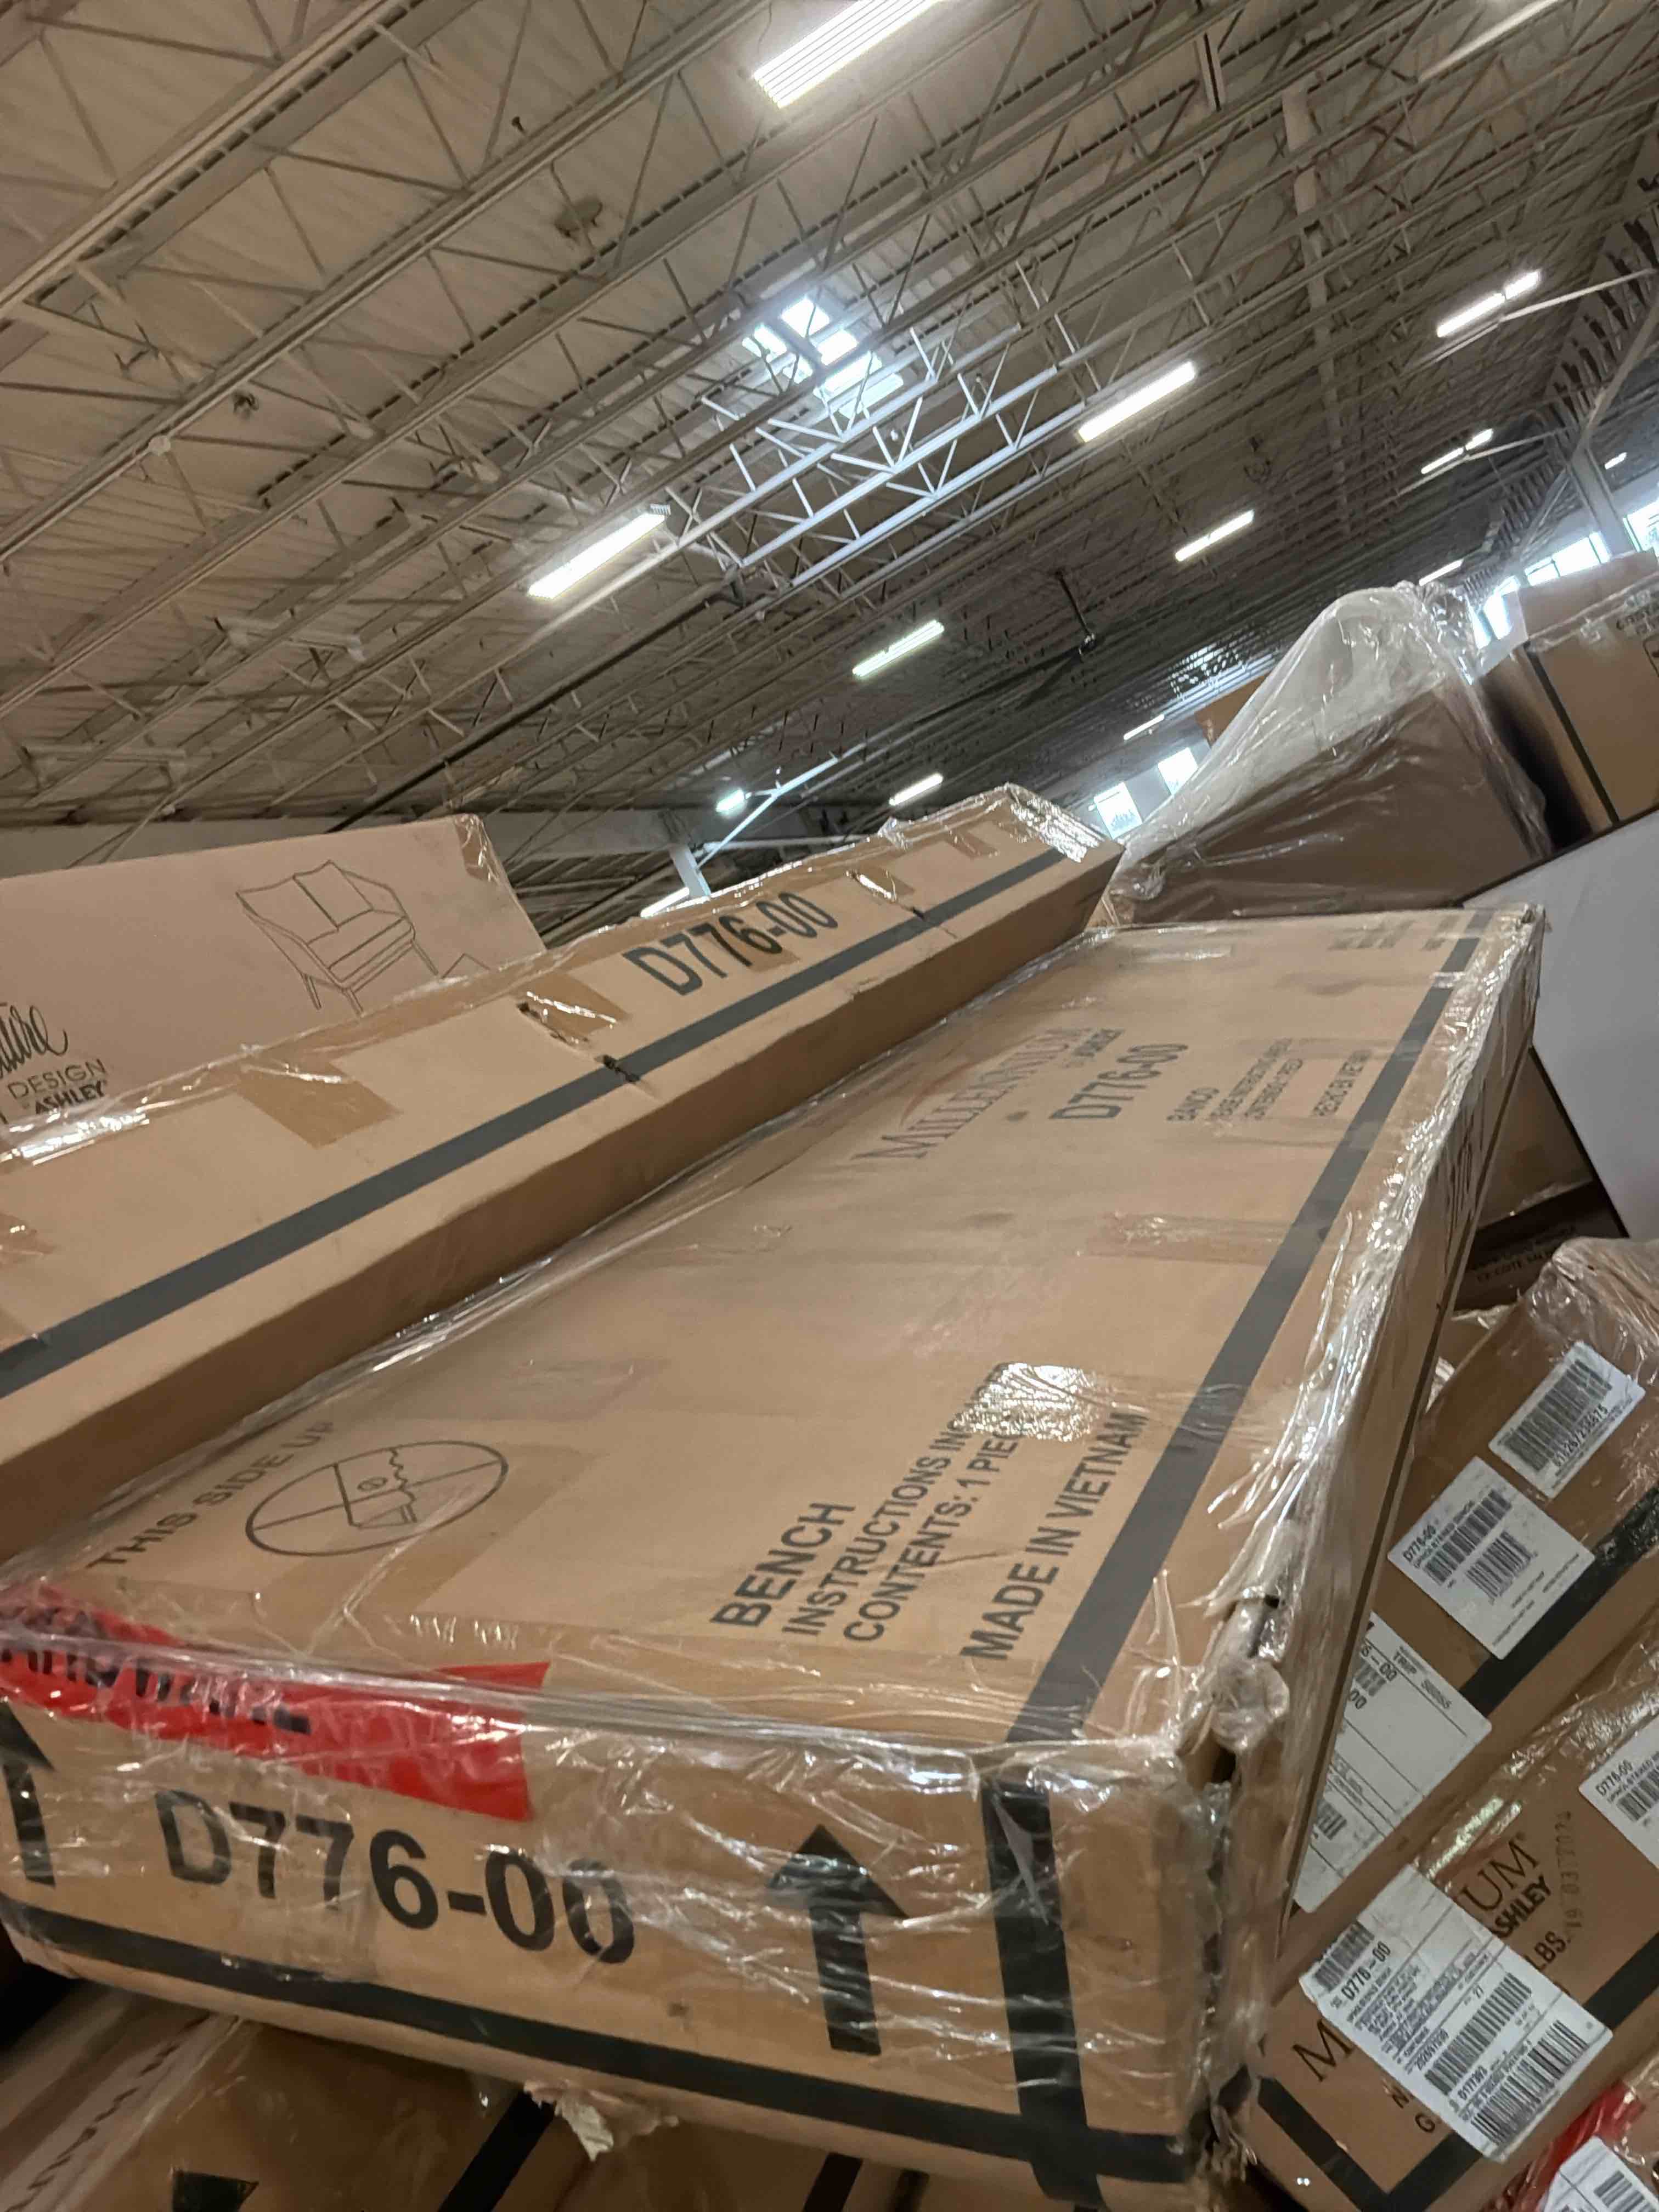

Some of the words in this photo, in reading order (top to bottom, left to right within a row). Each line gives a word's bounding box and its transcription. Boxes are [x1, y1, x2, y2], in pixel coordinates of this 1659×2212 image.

[621, 891, 839, 996] D776-00
[8, 1058, 107, 1099] DESIGN
[36, 1079, 108, 1114] ASHLEY
[1048, 1043, 1188, 1120] D776-00
[86, 1511, 198, 1569] THIS
[193, 1453, 295, 1506] SIDE
[1045, 1411, 1150, 1521] VIETNAM
[710, 1501, 856, 1627] BENCH
[782, 1454, 952, 1637] INSTRUCTIONS
[843, 1494, 978, 1643] CONTENTS:
[1025, 1526, 1081, 1557] IN
[959, 1560, 1060, 1661] MADE
[154, 1788, 635, 1965] D776-00
